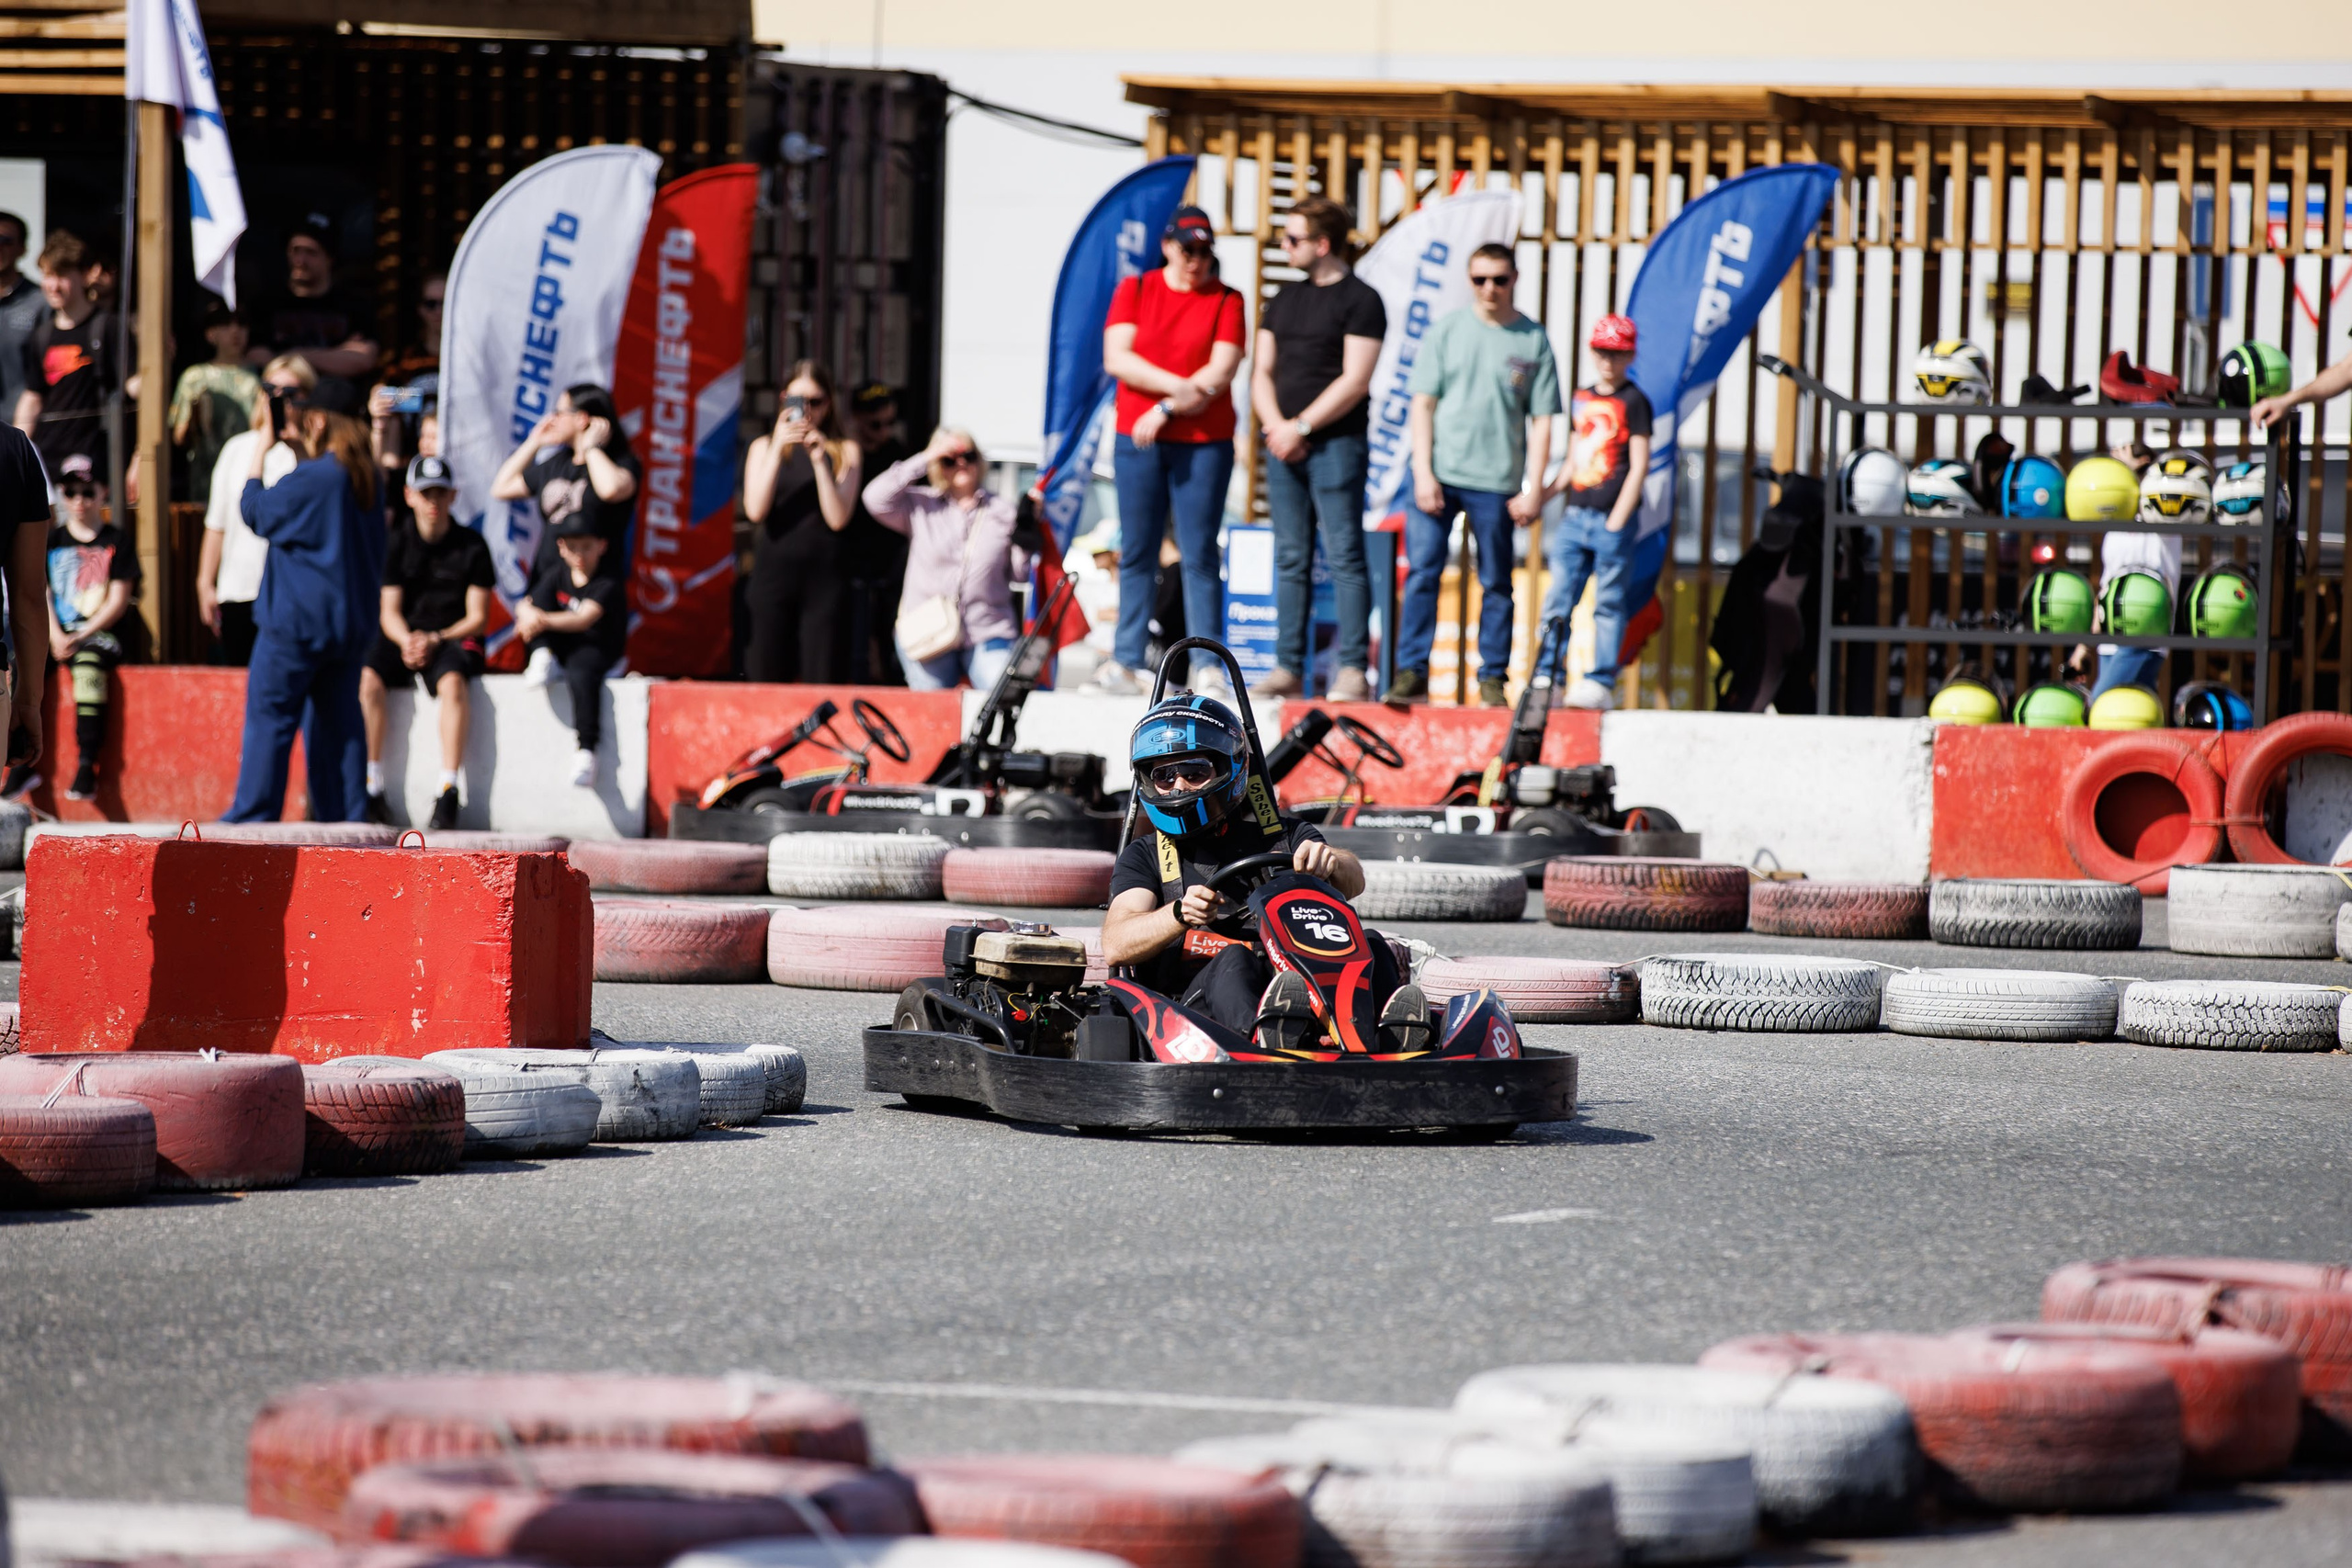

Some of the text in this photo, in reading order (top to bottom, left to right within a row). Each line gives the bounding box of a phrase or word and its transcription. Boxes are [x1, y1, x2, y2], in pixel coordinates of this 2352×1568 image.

[645, 227, 696, 557] ТРАНСНЕФТЬ
[1176, 710, 1225, 728] скорости
[1250, 782, 1272, 824] Sabel
[1291, 907, 1318, 915] Live
[1292, 913, 1328, 921] Drive
[1192, 935, 1228, 947] Live
[1305, 922, 1350, 942] 16
